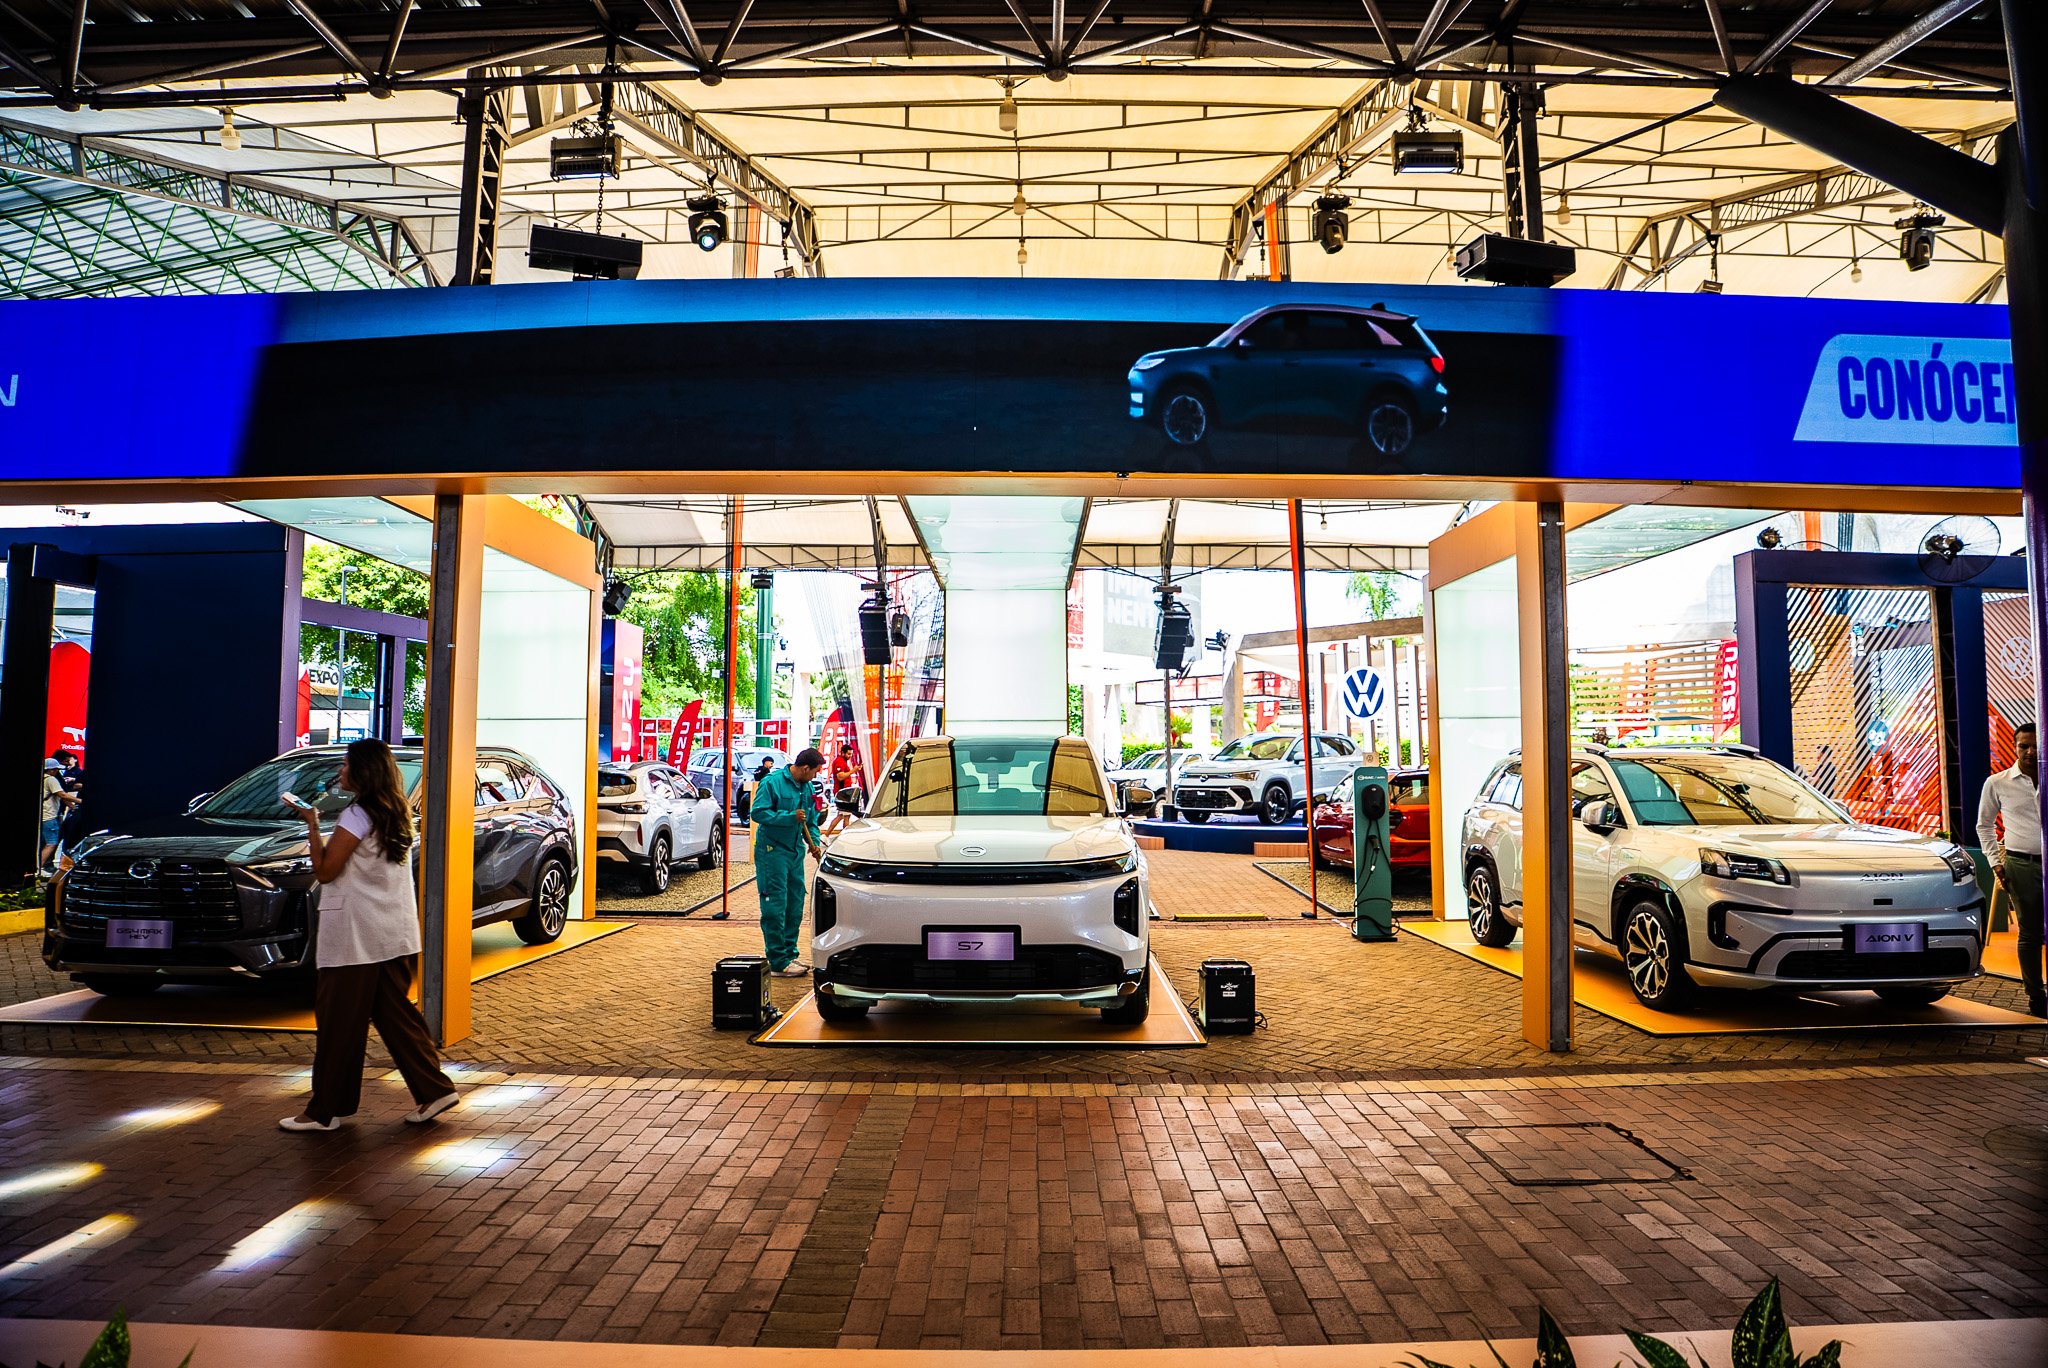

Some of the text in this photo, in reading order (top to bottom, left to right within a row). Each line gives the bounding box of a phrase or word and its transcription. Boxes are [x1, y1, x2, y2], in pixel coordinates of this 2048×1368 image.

[308, 668, 339, 686] EXPO
[1722, 646, 1738, 720] ISUZU
[620, 657, 634, 763] UZU
[957, 941, 984, 951] S7
[1865, 934, 1914, 943] AION V
